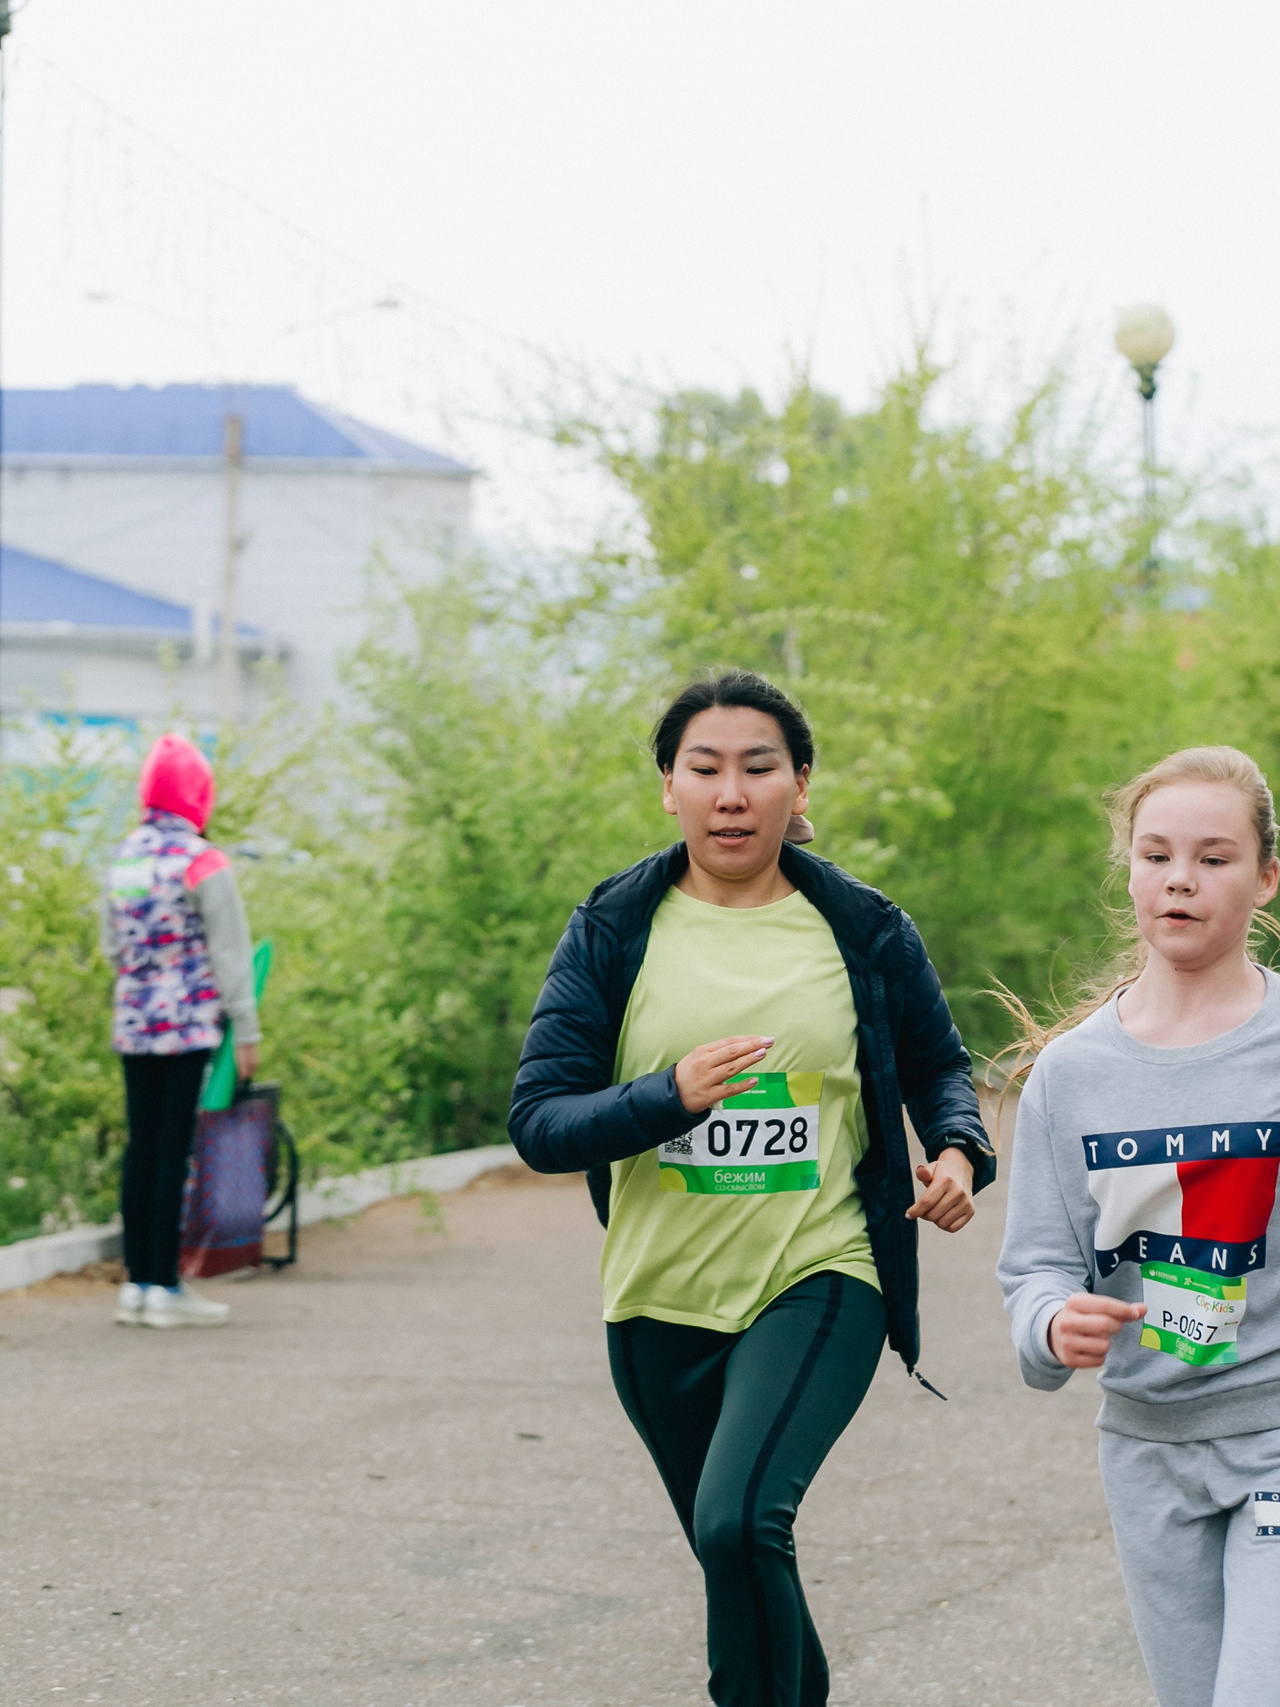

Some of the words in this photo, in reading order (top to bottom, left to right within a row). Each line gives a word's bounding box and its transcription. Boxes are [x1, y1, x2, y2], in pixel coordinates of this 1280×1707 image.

[707, 1116, 808, 1157] 0728
[1088, 1128, 1272, 1164] TOMMY
[714, 1169, 766, 1183] бежим
[1110, 1236, 1258, 1271] JEANS
[1162, 1310, 1218, 1343] P-0057
